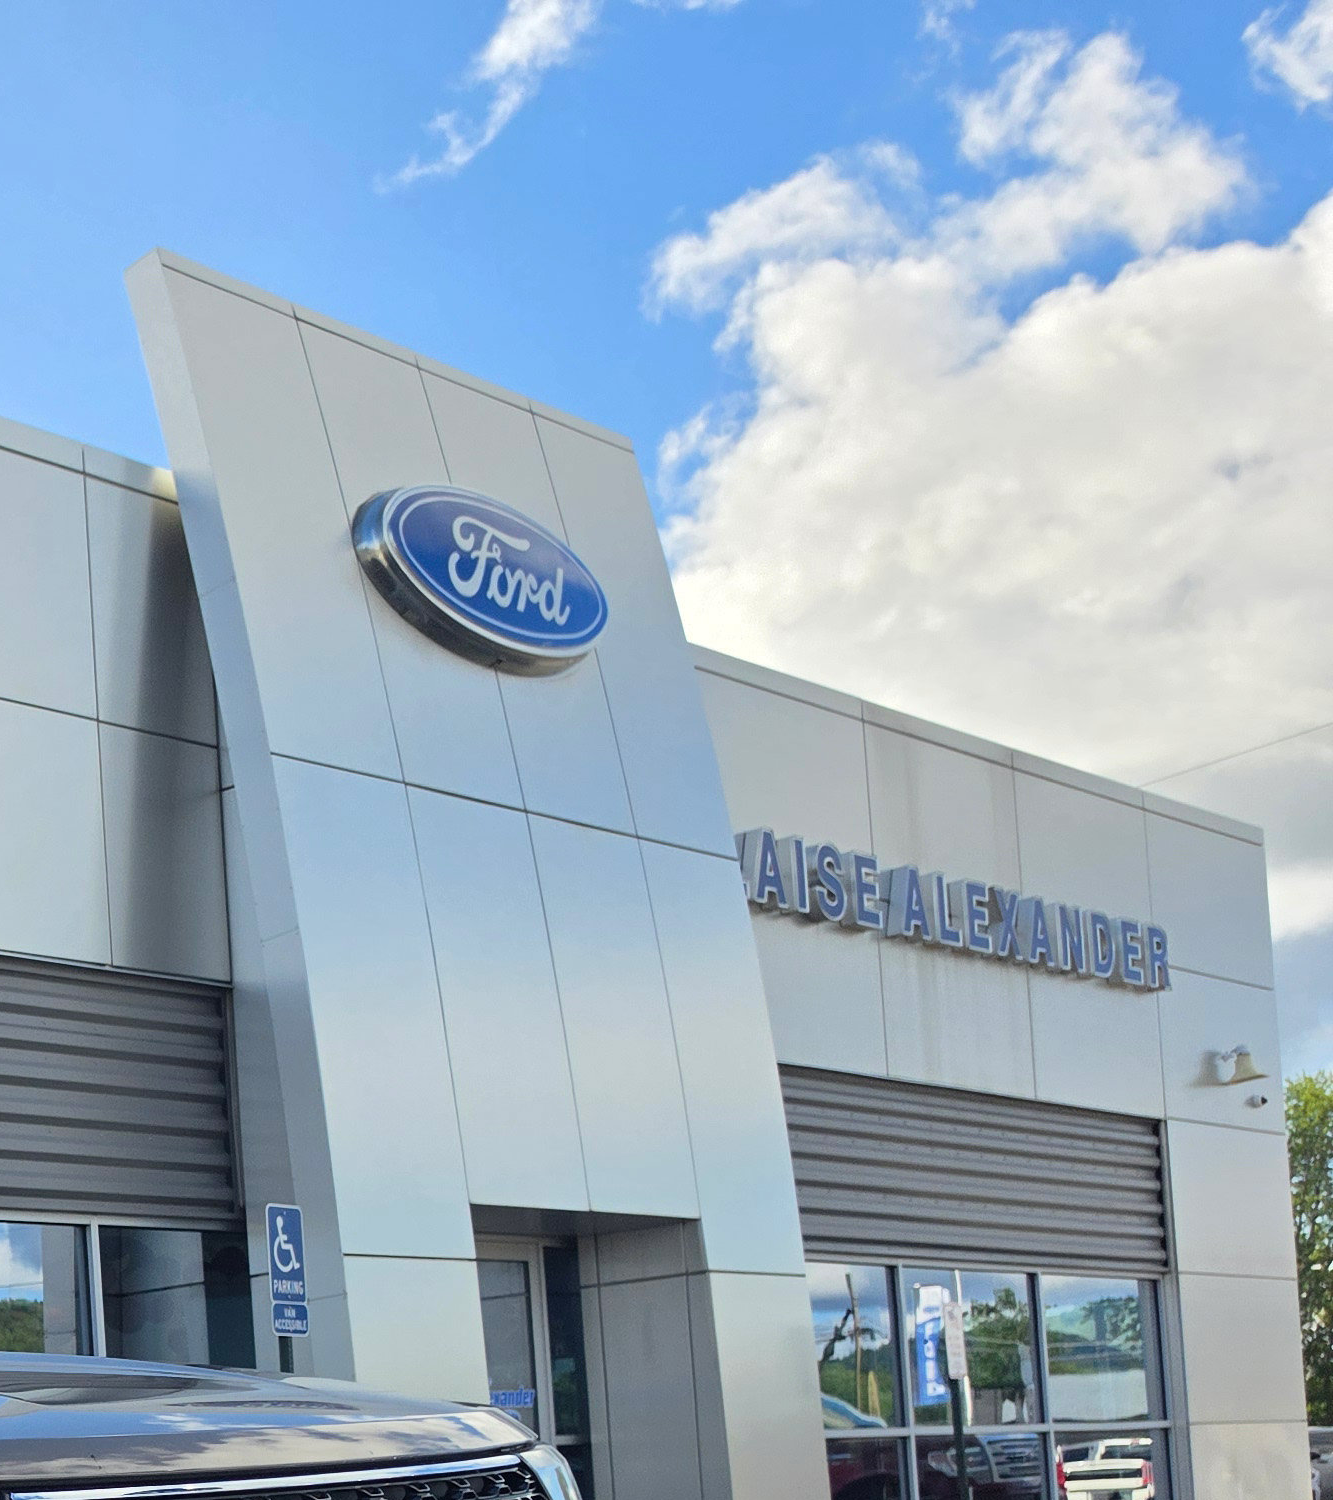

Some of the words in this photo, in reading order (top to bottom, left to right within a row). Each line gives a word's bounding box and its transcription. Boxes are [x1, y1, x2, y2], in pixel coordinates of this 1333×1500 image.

[447, 515, 571, 627] Ford
[744, 828, 884, 929] AISE
[895, 866, 1171, 991] ALEXANDER
[273, 1279, 304, 1295] PARKING
[284, 1308, 296, 1319] VAN
[275, 1319, 307, 1331] ACCESSIBLE
